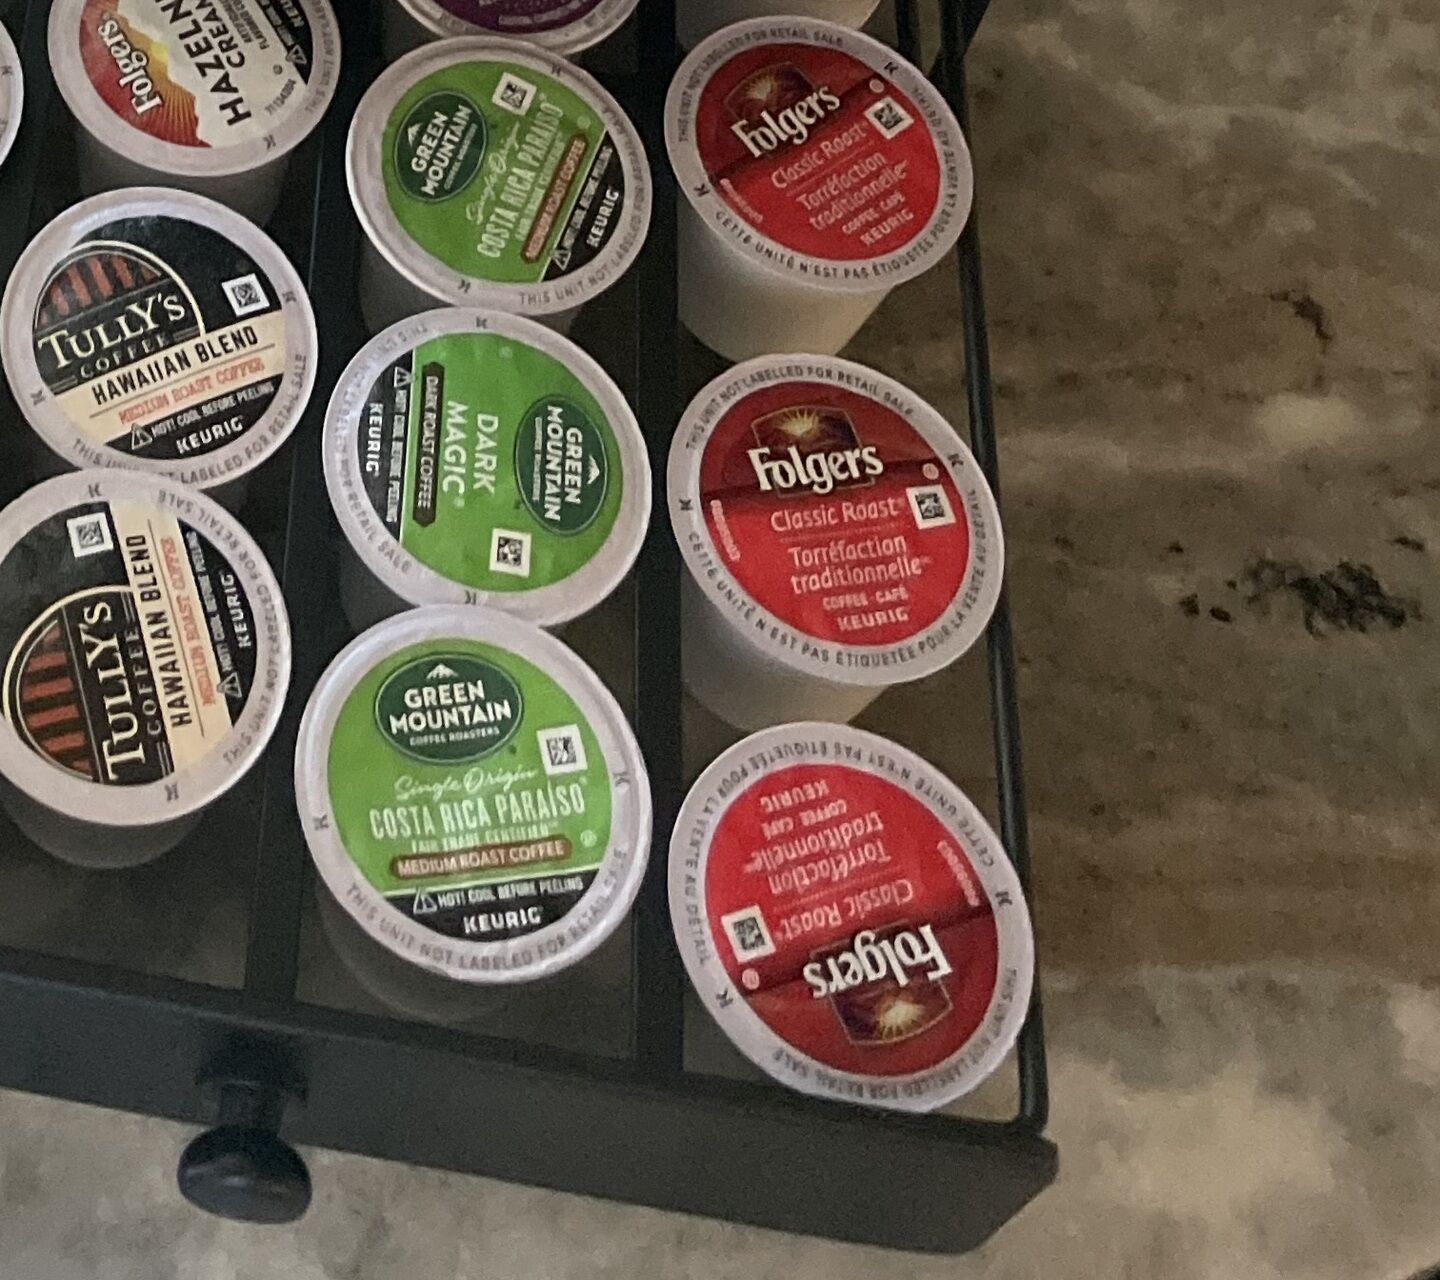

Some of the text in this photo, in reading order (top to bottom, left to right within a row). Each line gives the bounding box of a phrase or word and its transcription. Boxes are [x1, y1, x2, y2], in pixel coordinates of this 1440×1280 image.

[97, 18, 165, 117] Folgers
[410, 109, 450, 174] GREEN
[419, 104, 474, 197] MOUNTAIN
[729, 85, 842, 158] Folgers
[770, 122, 868, 190] Classic Roast
[795, 151, 888, 213] Torréfaction
[476, 165, 537, 259] COSTA RICA
[585, 187, 620, 248] KEURIG
[859, 209, 915, 248] KEURIG
[37, 293, 186, 370] TULLY'S
[79, 333, 174, 380] COFFEE
[91, 324, 259, 407] HAWAIIAN BLEND
[806, 365, 834, 381] FOR
[175, 416, 243, 455] KEURIG
[364, 401, 384, 475] KEURIG
[442, 399, 470, 495] MAGIC
[472, 412, 500, 495] DARK
[544, 404, 564, 522] MOUNTAIN
[179, 453, 244, 485] LABELED
[417, 455, 433, 510] COFFEE
[563, 426, 584, 506] GREEN
[746, 444, 886, 495] Folgers
[770, 500, 839, 534] Classic
[842, 496, 900, 523] Roast
[787, 534, 908, 570] Torréfaction
[790, 556, 923, 596] traditionnelle
[126, 533, 194, 729] HAWAIIAN BLEND
[219, 573, 252, 649] KEURIG
[837, 605, 910, 632] KEURIG
[123, 625, 162, 736] COFFEE
[800, 642, 831, 664] PAS
[78, 599, 146, 781] TULLY'S
[388, 699, 513, 736] MOUNTAIN
[403, 678, 487, 710] GREEN
[408, 725, 501, 747] COFFEE ROASTERS
[832, 740, 863, 760] PAS
[392, 763, 541, 804] Single Origin
[759, 778, 831, 813] KEURIG
[369, 804, 434, 841] COSTA
[438, 795, 492, 831] RICA
[757, 810, 885, 873] traditionnelle
[396, 839, 566, 877] MEDIUM ROAST COFFEE
[767, 838, 893, 897] Torréfaction
[462, 906, 543, 936] KEURIG
[780, 878, 915, 942] Classic Roast
[802, 924, 954, 1001] Folgers
